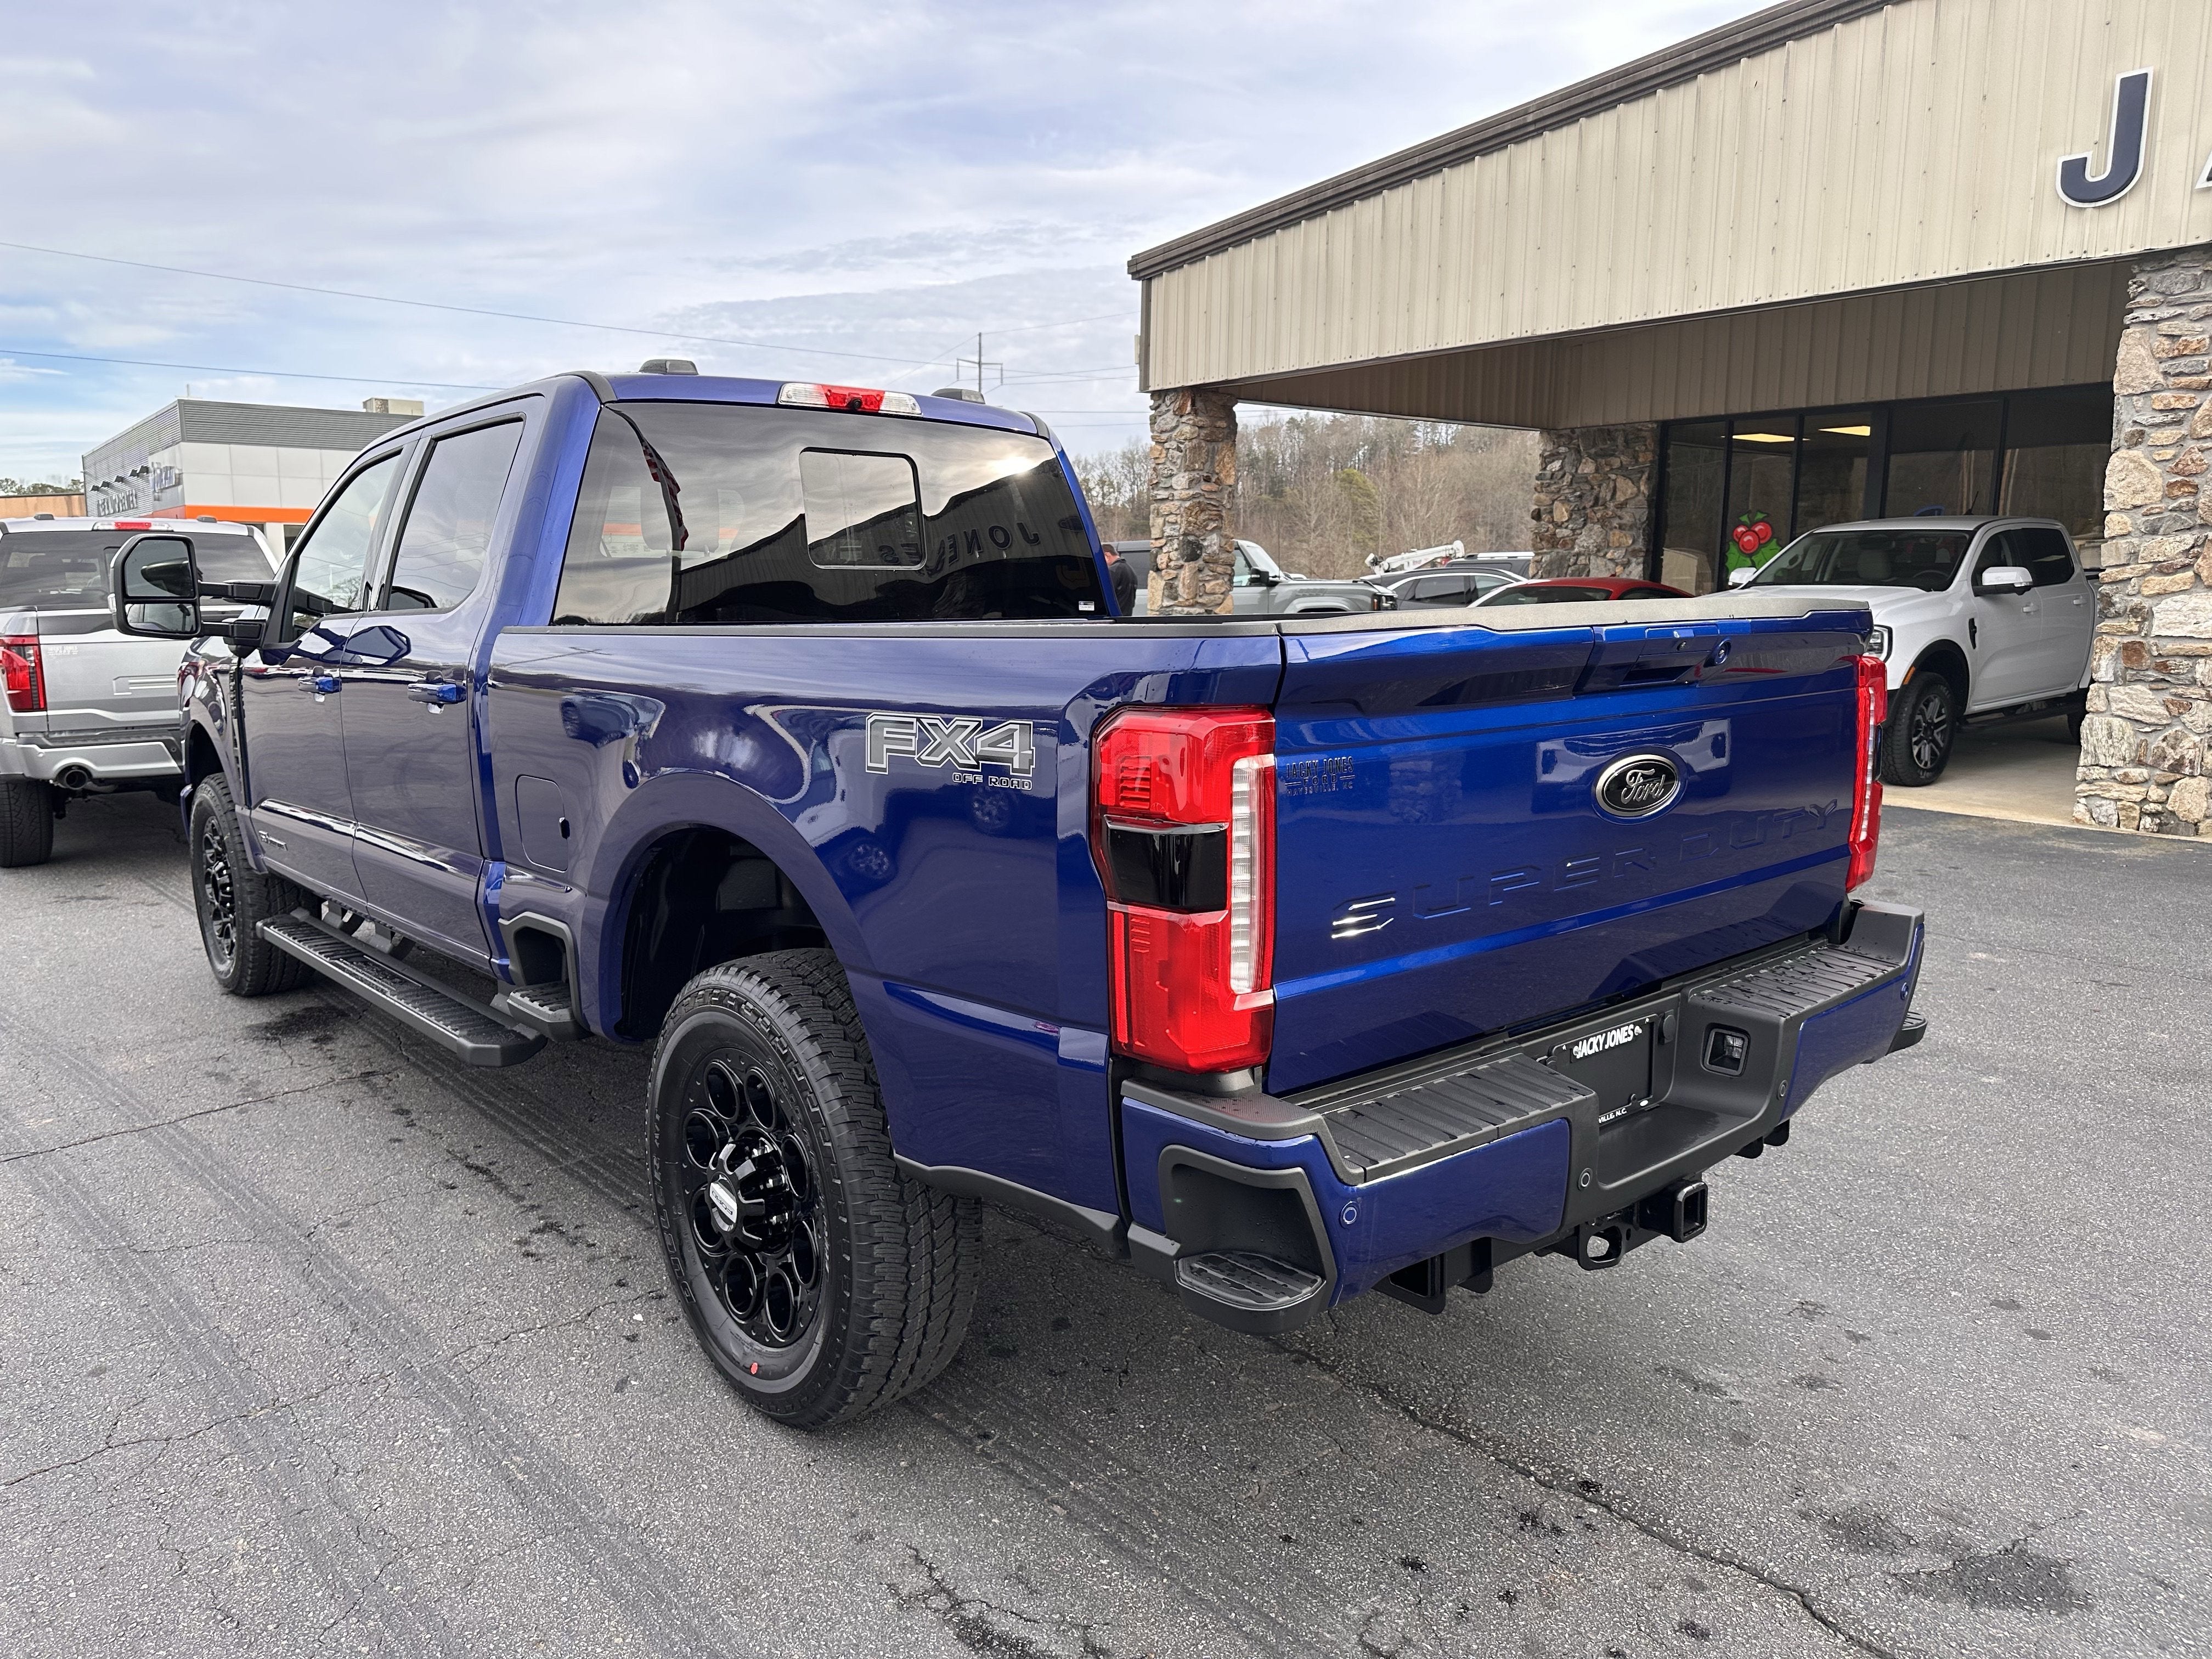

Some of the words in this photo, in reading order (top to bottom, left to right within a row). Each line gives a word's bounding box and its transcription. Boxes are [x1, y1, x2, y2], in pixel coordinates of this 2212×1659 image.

[2055, 66, 2212, 208] J
[865, 712, 1036, 777] FX4
[952, 772, 983, 785] OFF
[988, 775, 1032, 791] ROAD
[1286, 759, 1319, 779] JACKY
[1323, 756, 1354, 775] JONES
[1303, 774, 1338, 786] FORD
[1621, 768, 1666, 804] Ford
[1330, 843, 1657, 939] SUPER
[1680, 798, 1838, 863] DUTY
[1576, 1032, 1606, 1059] JACKY
[1604, 1024, 1634, 1049] JONES
[712, 1190, 733, 1216] FORD
